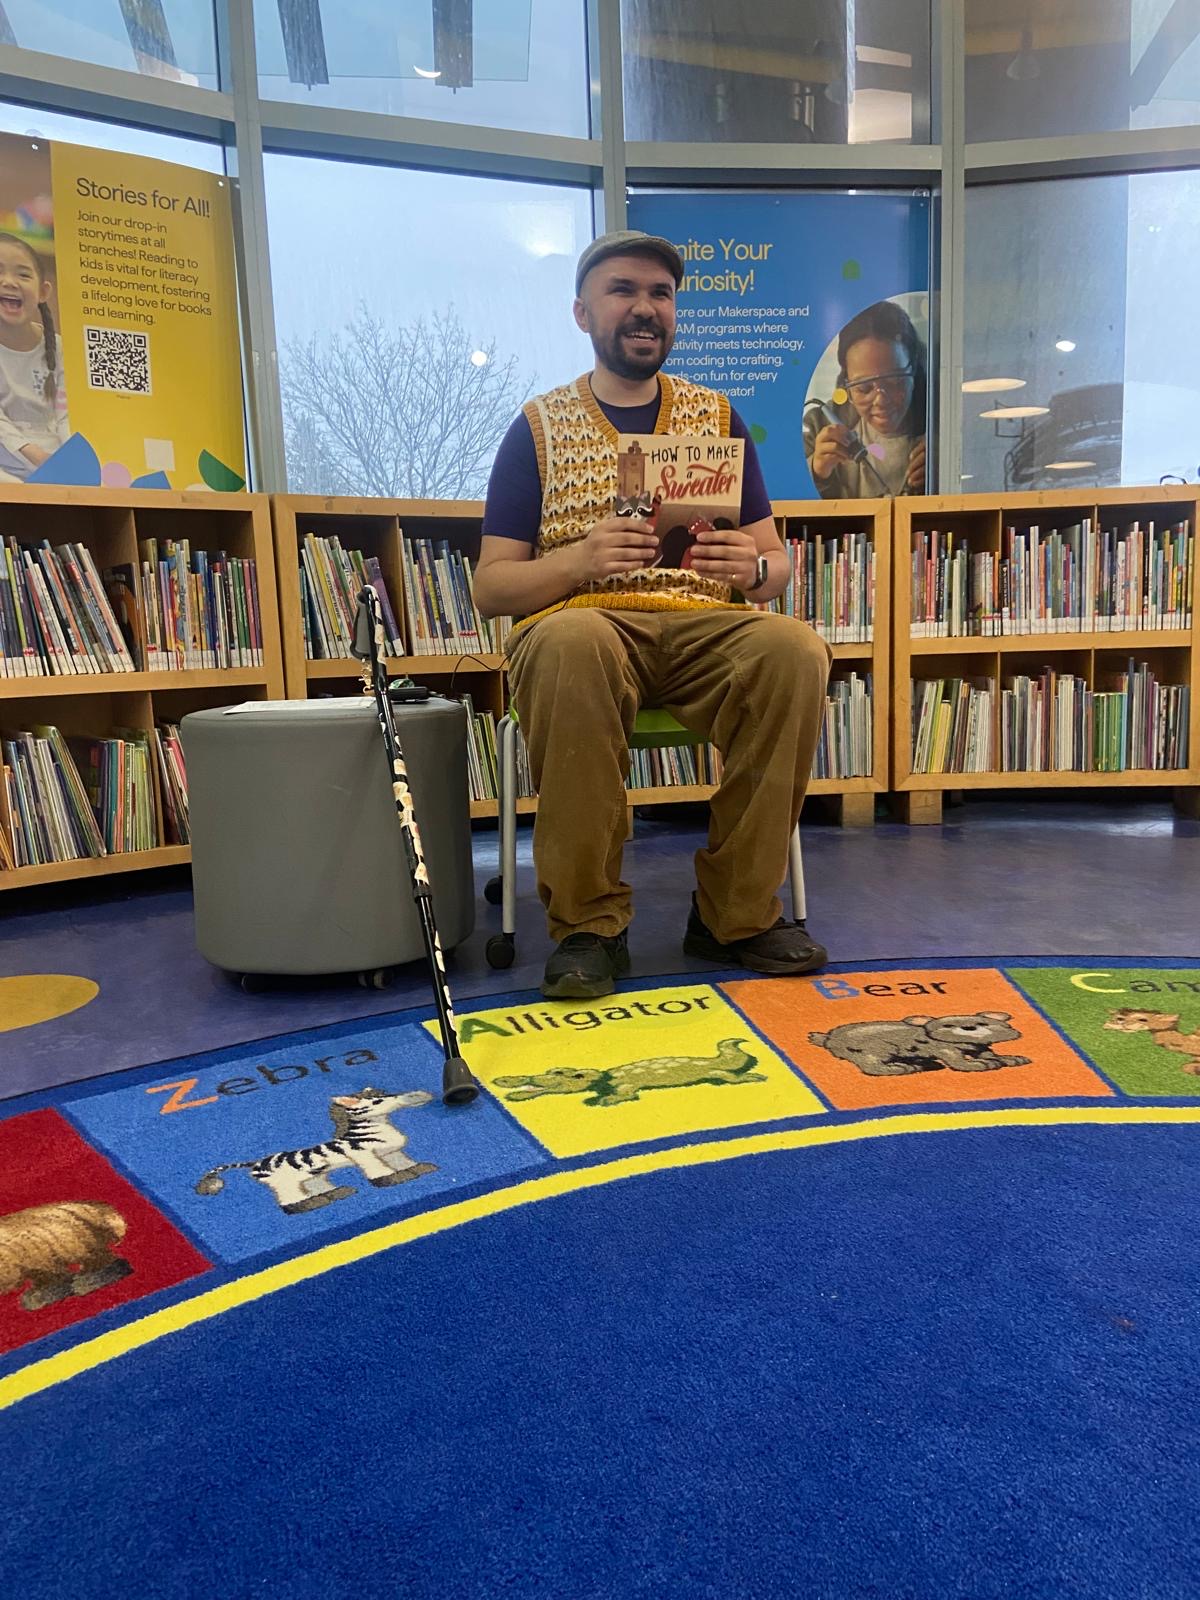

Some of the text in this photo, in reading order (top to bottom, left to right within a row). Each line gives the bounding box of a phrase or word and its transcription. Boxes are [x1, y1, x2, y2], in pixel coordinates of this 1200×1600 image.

[77, 178, 210, 218] Stories for All!
[78, 210, 167, 233] Join our drop-in
[78, 227, 165, 248] storytimes at all
[80, 242, 198, 269] branches! Reading to
[674, 238, 773, 261] nite Your
[80, 257, 199, 286] kids is vital for literacy
[677, 269, 754, 296] uriosity!
[82, 290, 211, 315] a lifelong love for books
[162, 285, 210, 302] fostering
[83, 305, 156, 325] and learning.
[697, 308, 717, 318] our
[718, 306, 786, 319] Makerspace
[788, 305, 809, 317] and
[697, 325, 751, 336] programs
[753, 322, 789, 333] where
[672, 337, 805, 353] ativity meets technology.
[665, 357, 685, 366] om
[686, 355, 725, 368] coding
[727, 356, 737, 366] to
[677, 370, 778, 383] ds-on fun for every
[716, 386, 755, 397] ovator!
[651, 444, 739, 464] HOW TO MAKE
[655, 460, 737, 500] Sweater
[686, 471, 693, 479] a
[810, 978, 948, 1000] Bear
[459, 993, 711, 1043] Alligator
[145, 1047, 378, 1115] Zebra
